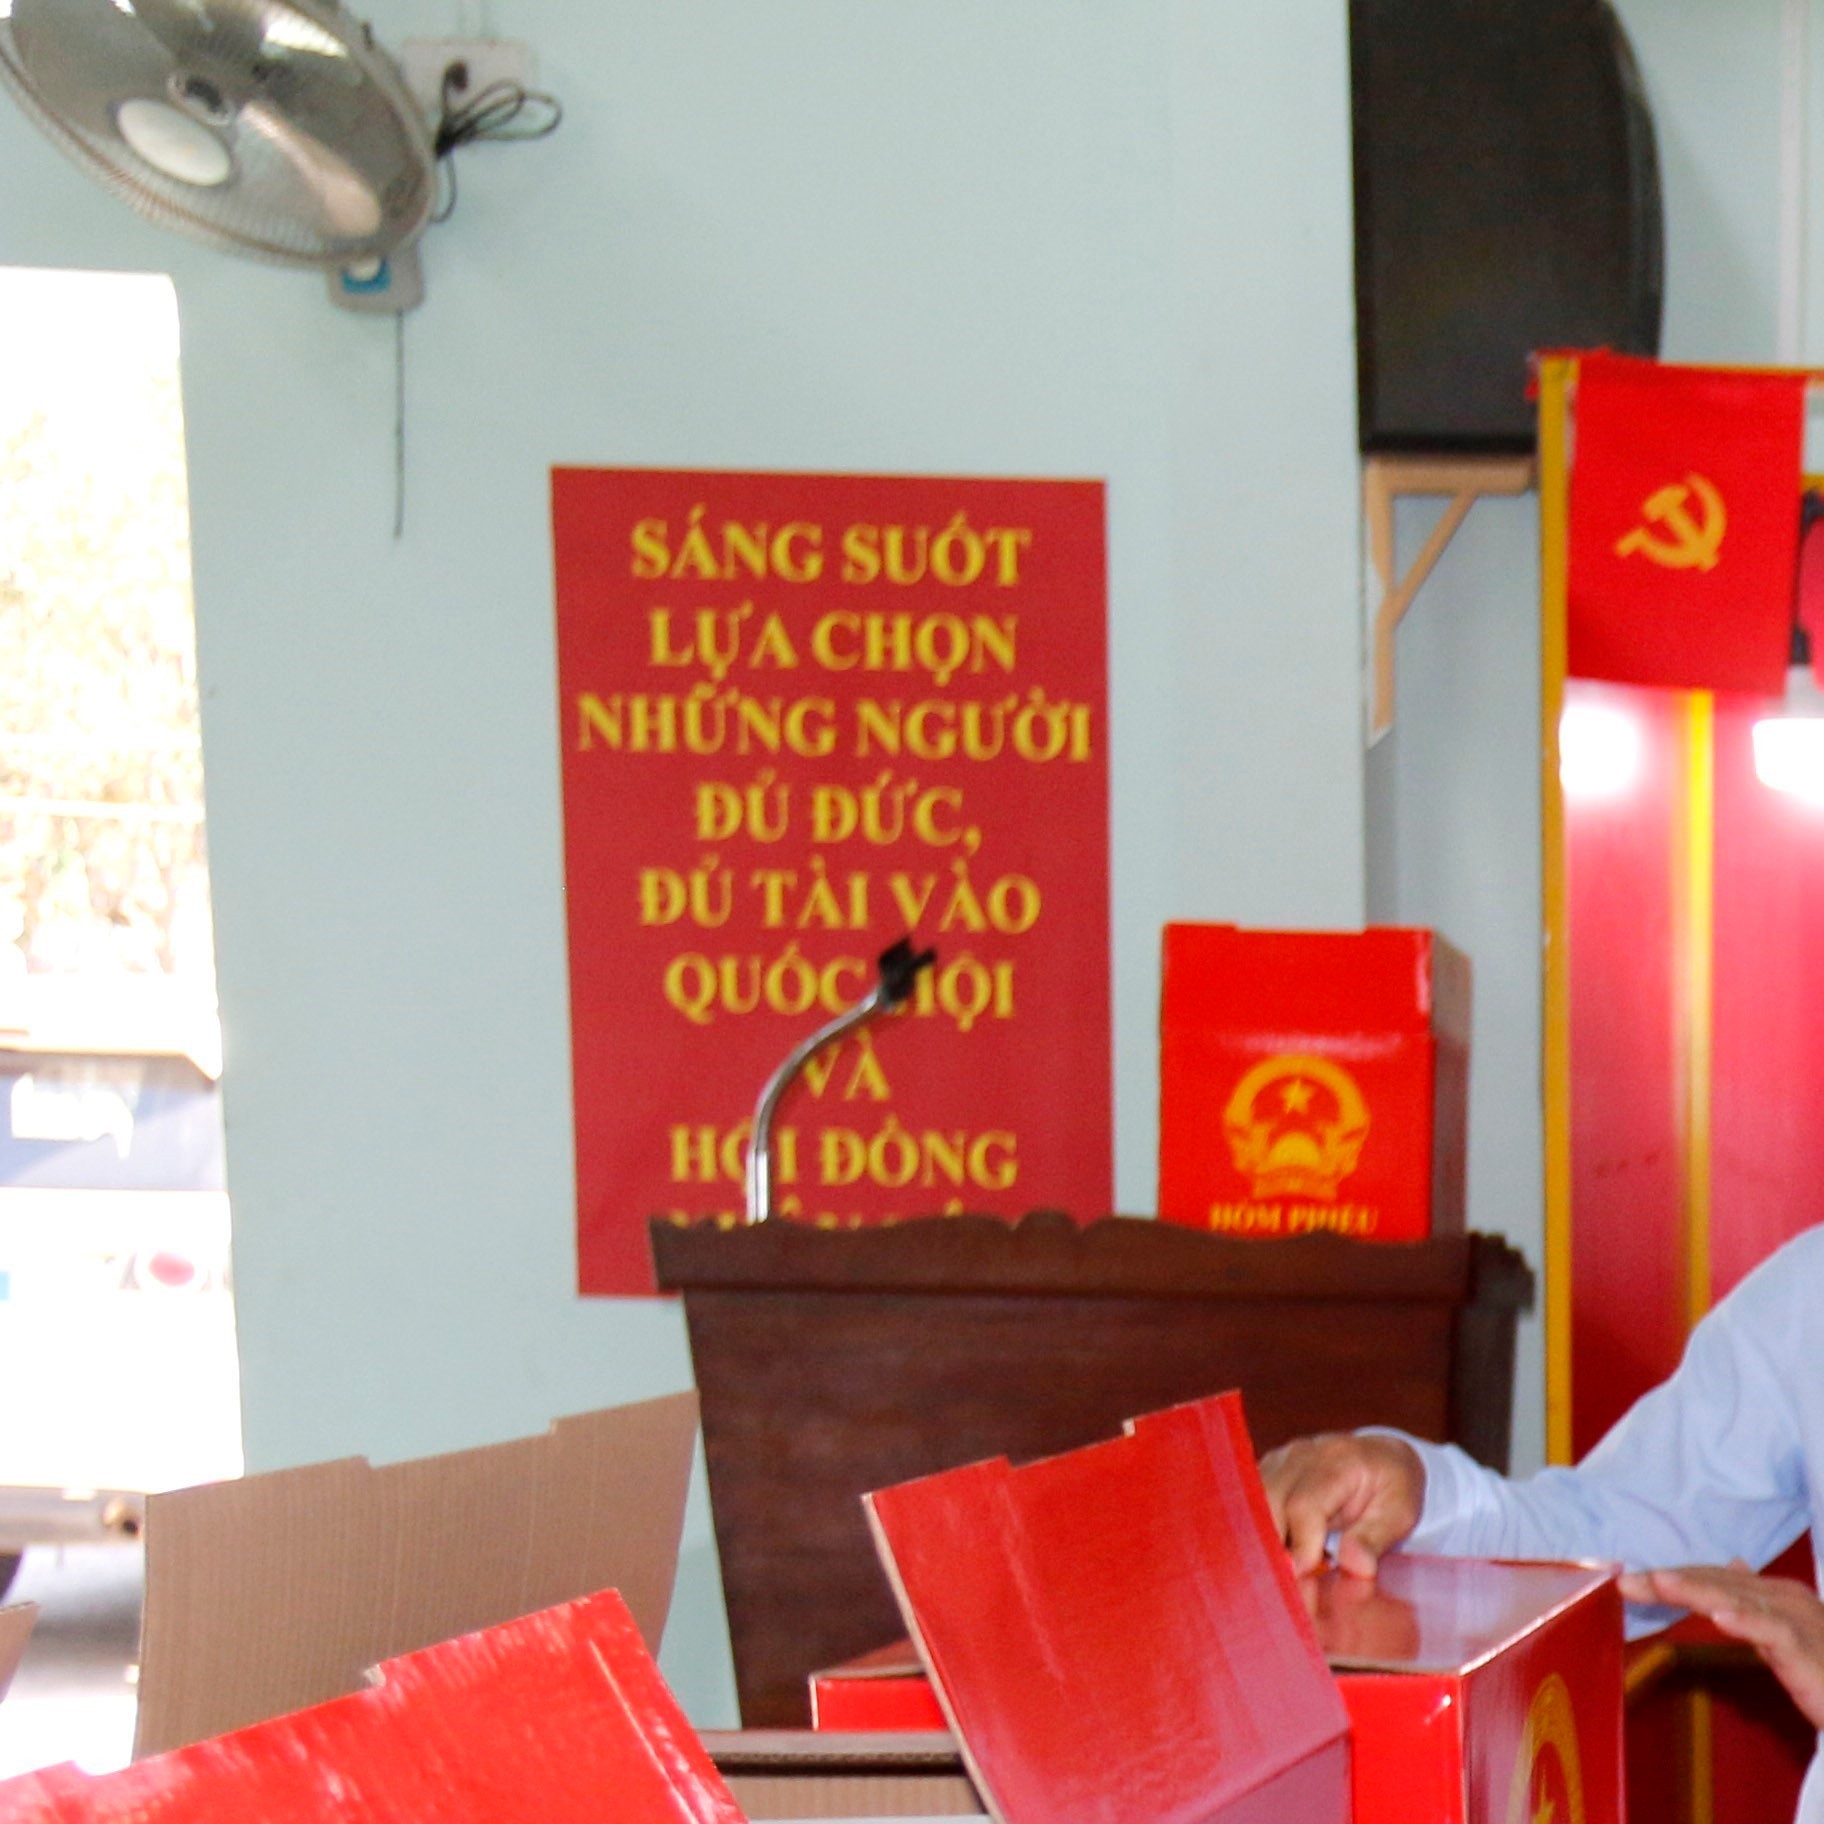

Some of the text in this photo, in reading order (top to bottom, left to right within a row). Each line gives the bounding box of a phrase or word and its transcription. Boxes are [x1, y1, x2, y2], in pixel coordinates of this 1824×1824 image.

[630, 502, 1033, 588] SÁNG SUỐT
[648, 599, 1019, 687] LỰA CHỌN
[578, 681, 1092, 763] NHỮNG NGƯỜI
[812, 768, 982, 857] ĐỨC,
[749, 853, 870, 930] TÀI
[889, 857, 1042, 934] VÀO
[663, 938, 1016, 1033] QUỐC ỘI
[820, 1112, 1019, 1190] ĐỒNG
